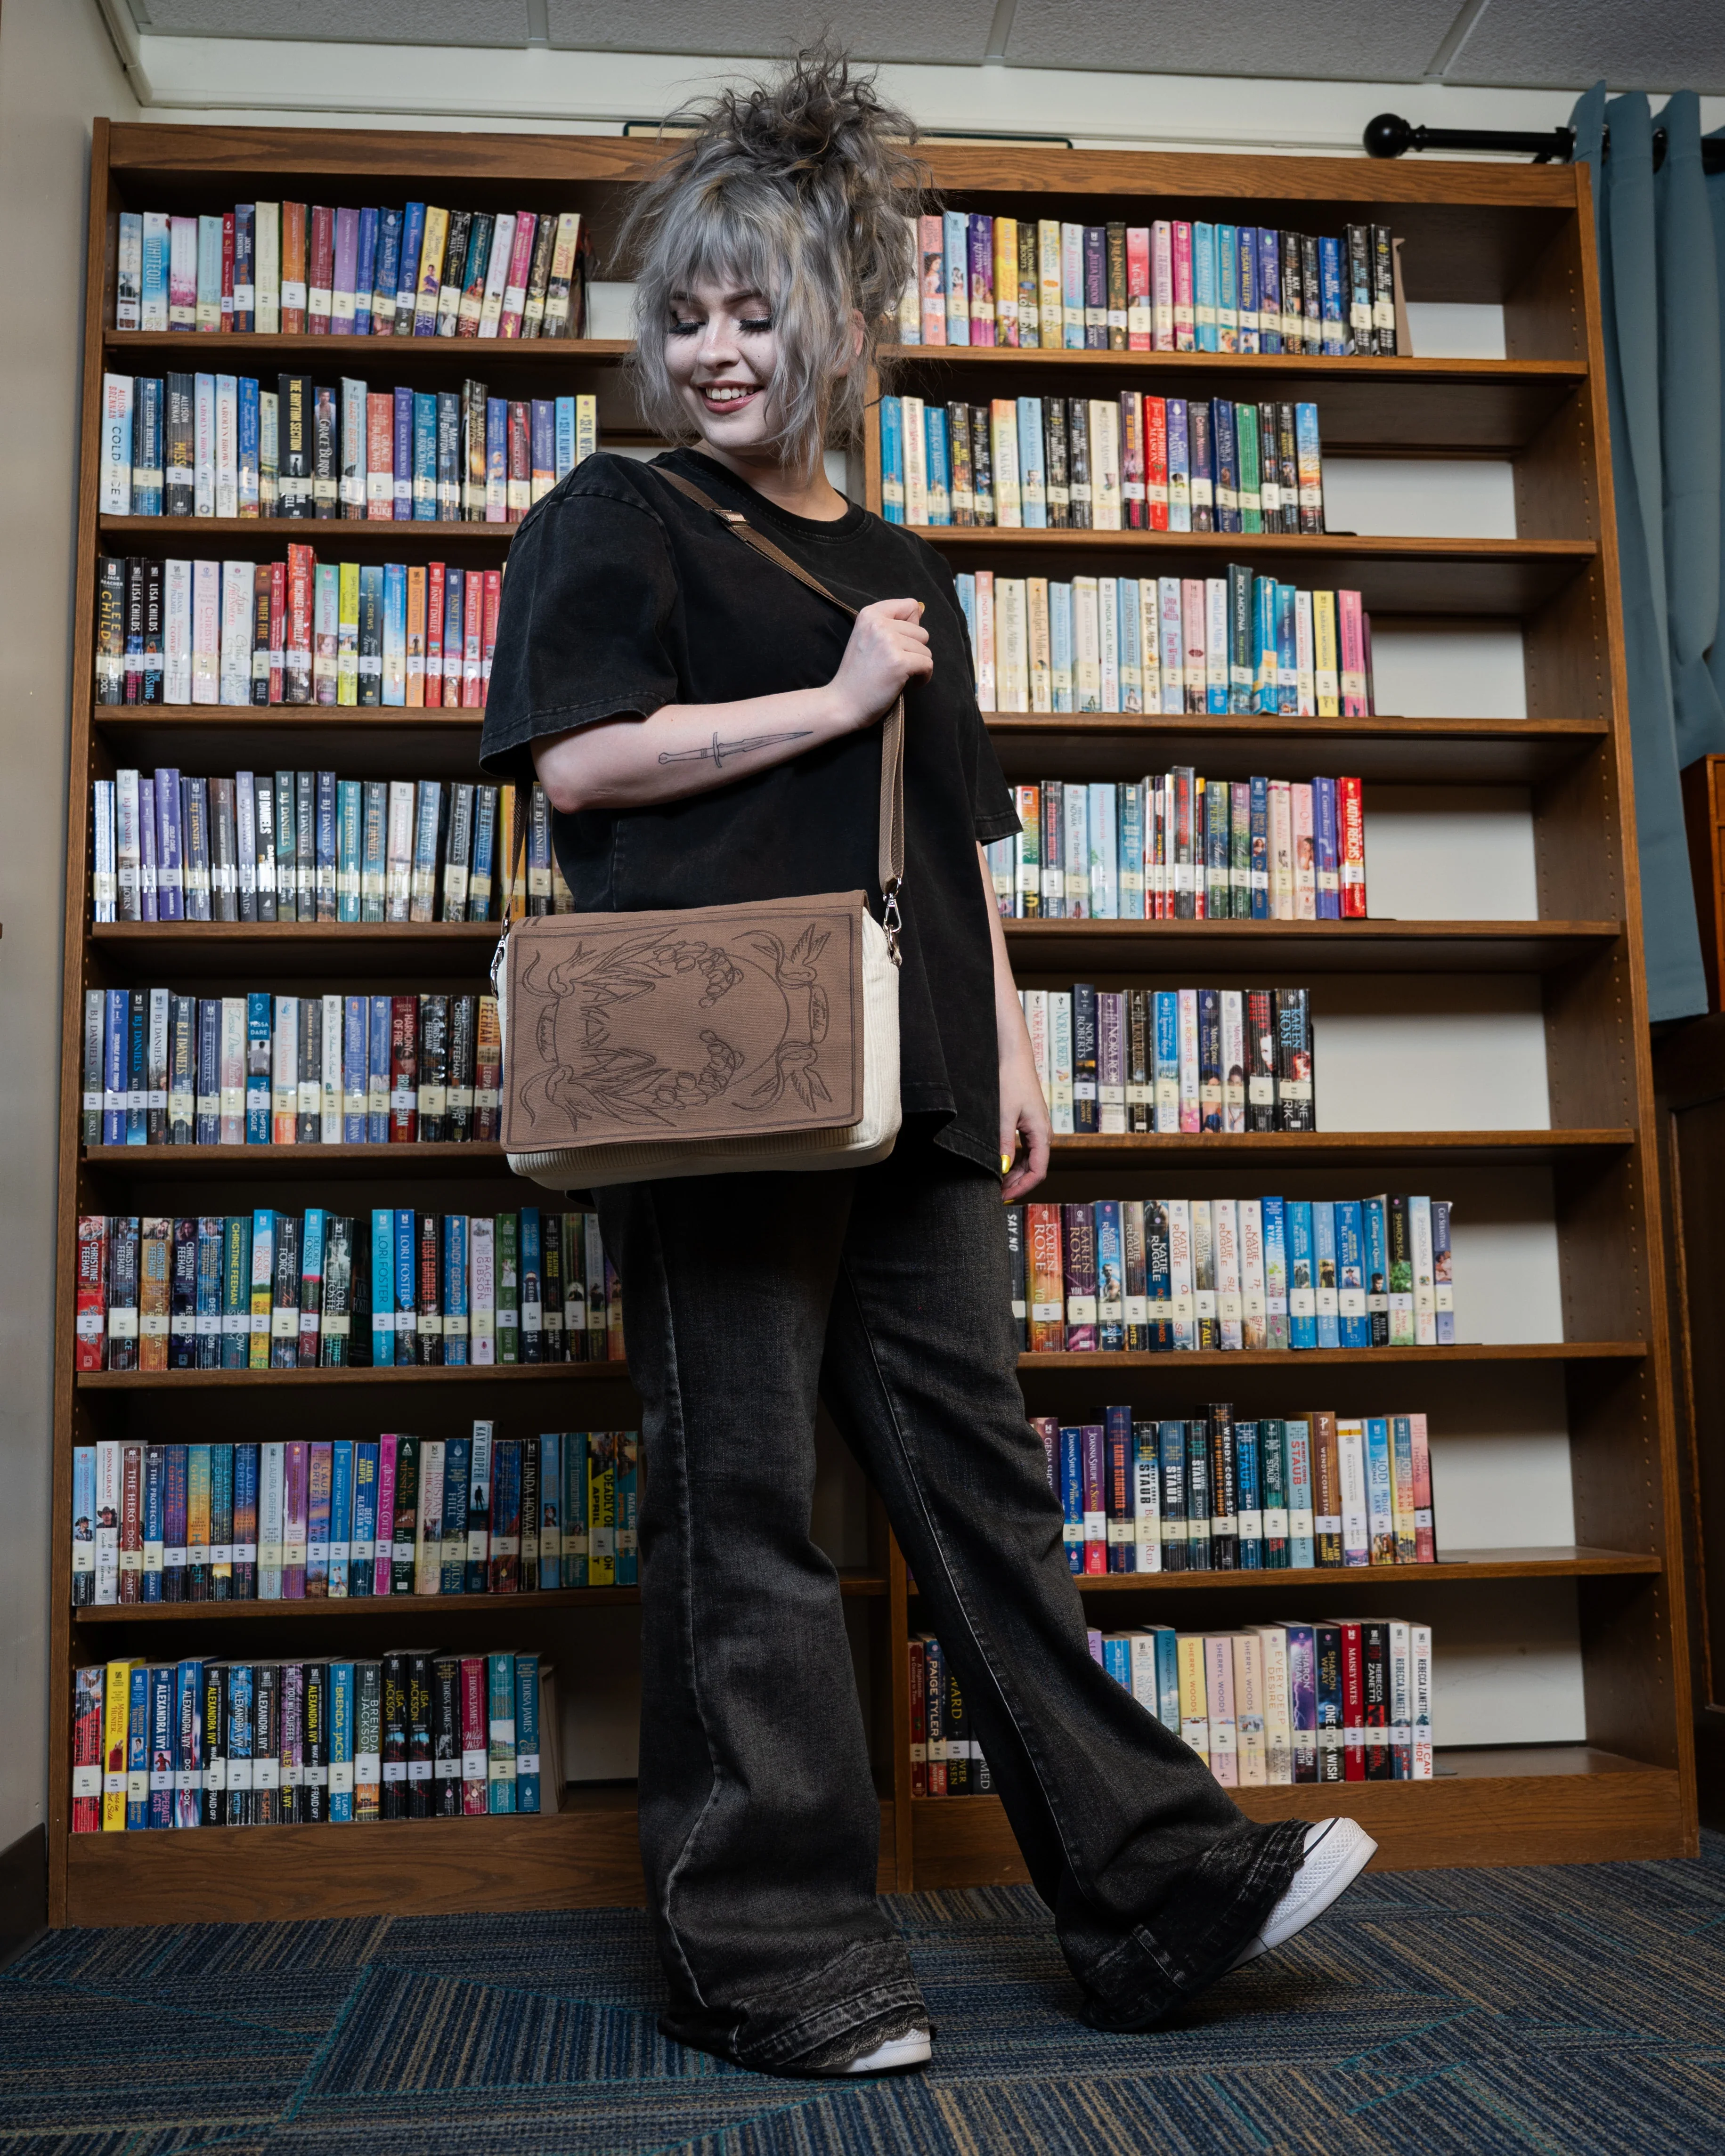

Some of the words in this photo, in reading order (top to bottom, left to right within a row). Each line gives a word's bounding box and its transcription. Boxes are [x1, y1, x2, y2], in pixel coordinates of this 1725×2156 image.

[146, 239, 161, 289] WHITEOUT
[290, 380, 301, 392] THE
[108, 386, 117, 419] BRENNAN
[118, 389, 126, 418] ALLISON
[290, 393, 301, 421] RHYTHM
[111, 427, 121, 461] COLD
[290, 422, 301, 451] SECTION
[348, 428, 357, 462] BURTON
[371, 426, 381, 470] BURROWES
[382, 435, 390, 462] GRACE
[131, 584, 140, 601] LISA
[294, 580, 304, 607] MICHAEL
[1237, 575, 1245, 596] RICK
[101, 591, 112, 640] CHILD
[112, 601, 121, 631] LEE
[131, 604, 140, 631] CHILDS
[258, 596, 268, 620] UNDER
[258, 624, 268, 639] FIRE
[293, 610, 303, 642] CONNELLY
[257, 682, 266, 699] COLE
[260, 802, 272, 834] DANIELS
[1347, 799, 1357, 827] KATHY
[322, 814, 331, 857] DANIELS
[1348, 828, 1359, 858] REICHS
[228, 1010, 242, 1033] Tessa
[280, 1021, 292, 1041] Jude
[394, 1020, 403, 1029] OF
[454, 1002, 462, 1044] CHRISTINE
[1077, 1015, 1086, 1059] ROBERTS
[1280, 1010, 1291, 1048] ROSE
[1292, 1009, 1301, 1048] KAREN
[90, 1025, 98, 1066] DANIELS
[394, 1031, 402, 1046] FIRE
[280, 1045, 291, 1082] Deveraux
[453, 1046, 461, 1078] FEEHAN
[1007, 1214, 1017, 1234] SAY
[1267, 1225, 1275, 1249] RYAN
[1275, 1216, 1283, 1259] JENNIFER
[1394, 1213, 1402, 1242] SHARON
[379, 1235, 388, 1259] LORI
[422, 1241, 436, 1258] LISA
[451, 1236, 461, 1264] CINDY
[1009, 1237, 1018, 1252] NO
[1069, 1227, 1081, 1273] ROSE
[1081, 1226, 1090, 1273] KAREN
[1151, 1235, 1161, 1281] RUGGLE
[1159, 1242, 1168, 1274] KATIE
[81, 1247, 90, 1277] FEEHAN
[90, 1242, 98, 1281] CHRISTINE
[254, 1246, 262, 1280] FOSSEN
[378, 1262, 388, 1303] FOSTER
[422, 1261, 436, 1300] GARDNER
[451, 1267, 461, 1305] GERARD
[1202, 1328, 1211, 1345] ALL
[475, 1427, 486, 1442] KAY
[1087, 1430, 1097, 1458] JOANNA
[1223, 1427, 1231, 1462] WENDY
[473, 1446, 485, 1478] HOOPER
[1089, 1458, 1098, 1481] SHUPE
[1114, 1444, 1123, 1466] KARIN
[312, 1462, 321, 1507] GRIFFIN
[1139, 1464, 1150, 1504] STAUB
[1377, 1459, 1388, 1483] JODI
[1114, 1469, 1125, 1508] SLAUGHTER
[127, 1494, 135, 1523] HERO
[448, 1493, 456, 1517] HILL
[456, 1483, 466, 1526] SANDRA
[1244, 1641, 1252, 1675] SHERRYL
[1275, 1651, 1284, 1689] EVERY
[1321, 1657, 1329, 1685] WRAY
[1327, 1650, 1336, 1690] SHARON
[1348, 1647, 1357, 1678] MAISEY
[287, 1687, 295, 1700] YOU
[929, 1661, 938, 1695] PAIGE
[1350, 1680, 1358, 1705] YATES
[1367, 1663, 1375, 1702] ZANETTI
[156, 1684, 166, 1734] ALEXANDRA
[386, 1679, 395, 1720] JACKSON
[396, 1690, 405, 1707] LISA
[1277, 1694, 1286, 1725] DEEP
[286, 1716, 294, 1741] SUFFER
[361, 1696, 370, 1753] JACKSON
[370, 1700, 379, 1752] BRENDA
[930, 1699, 939, 1736] TYLER
[156, 1735, 165, 1749] IVY
[153, 1793, 161, 1812] ACTS
